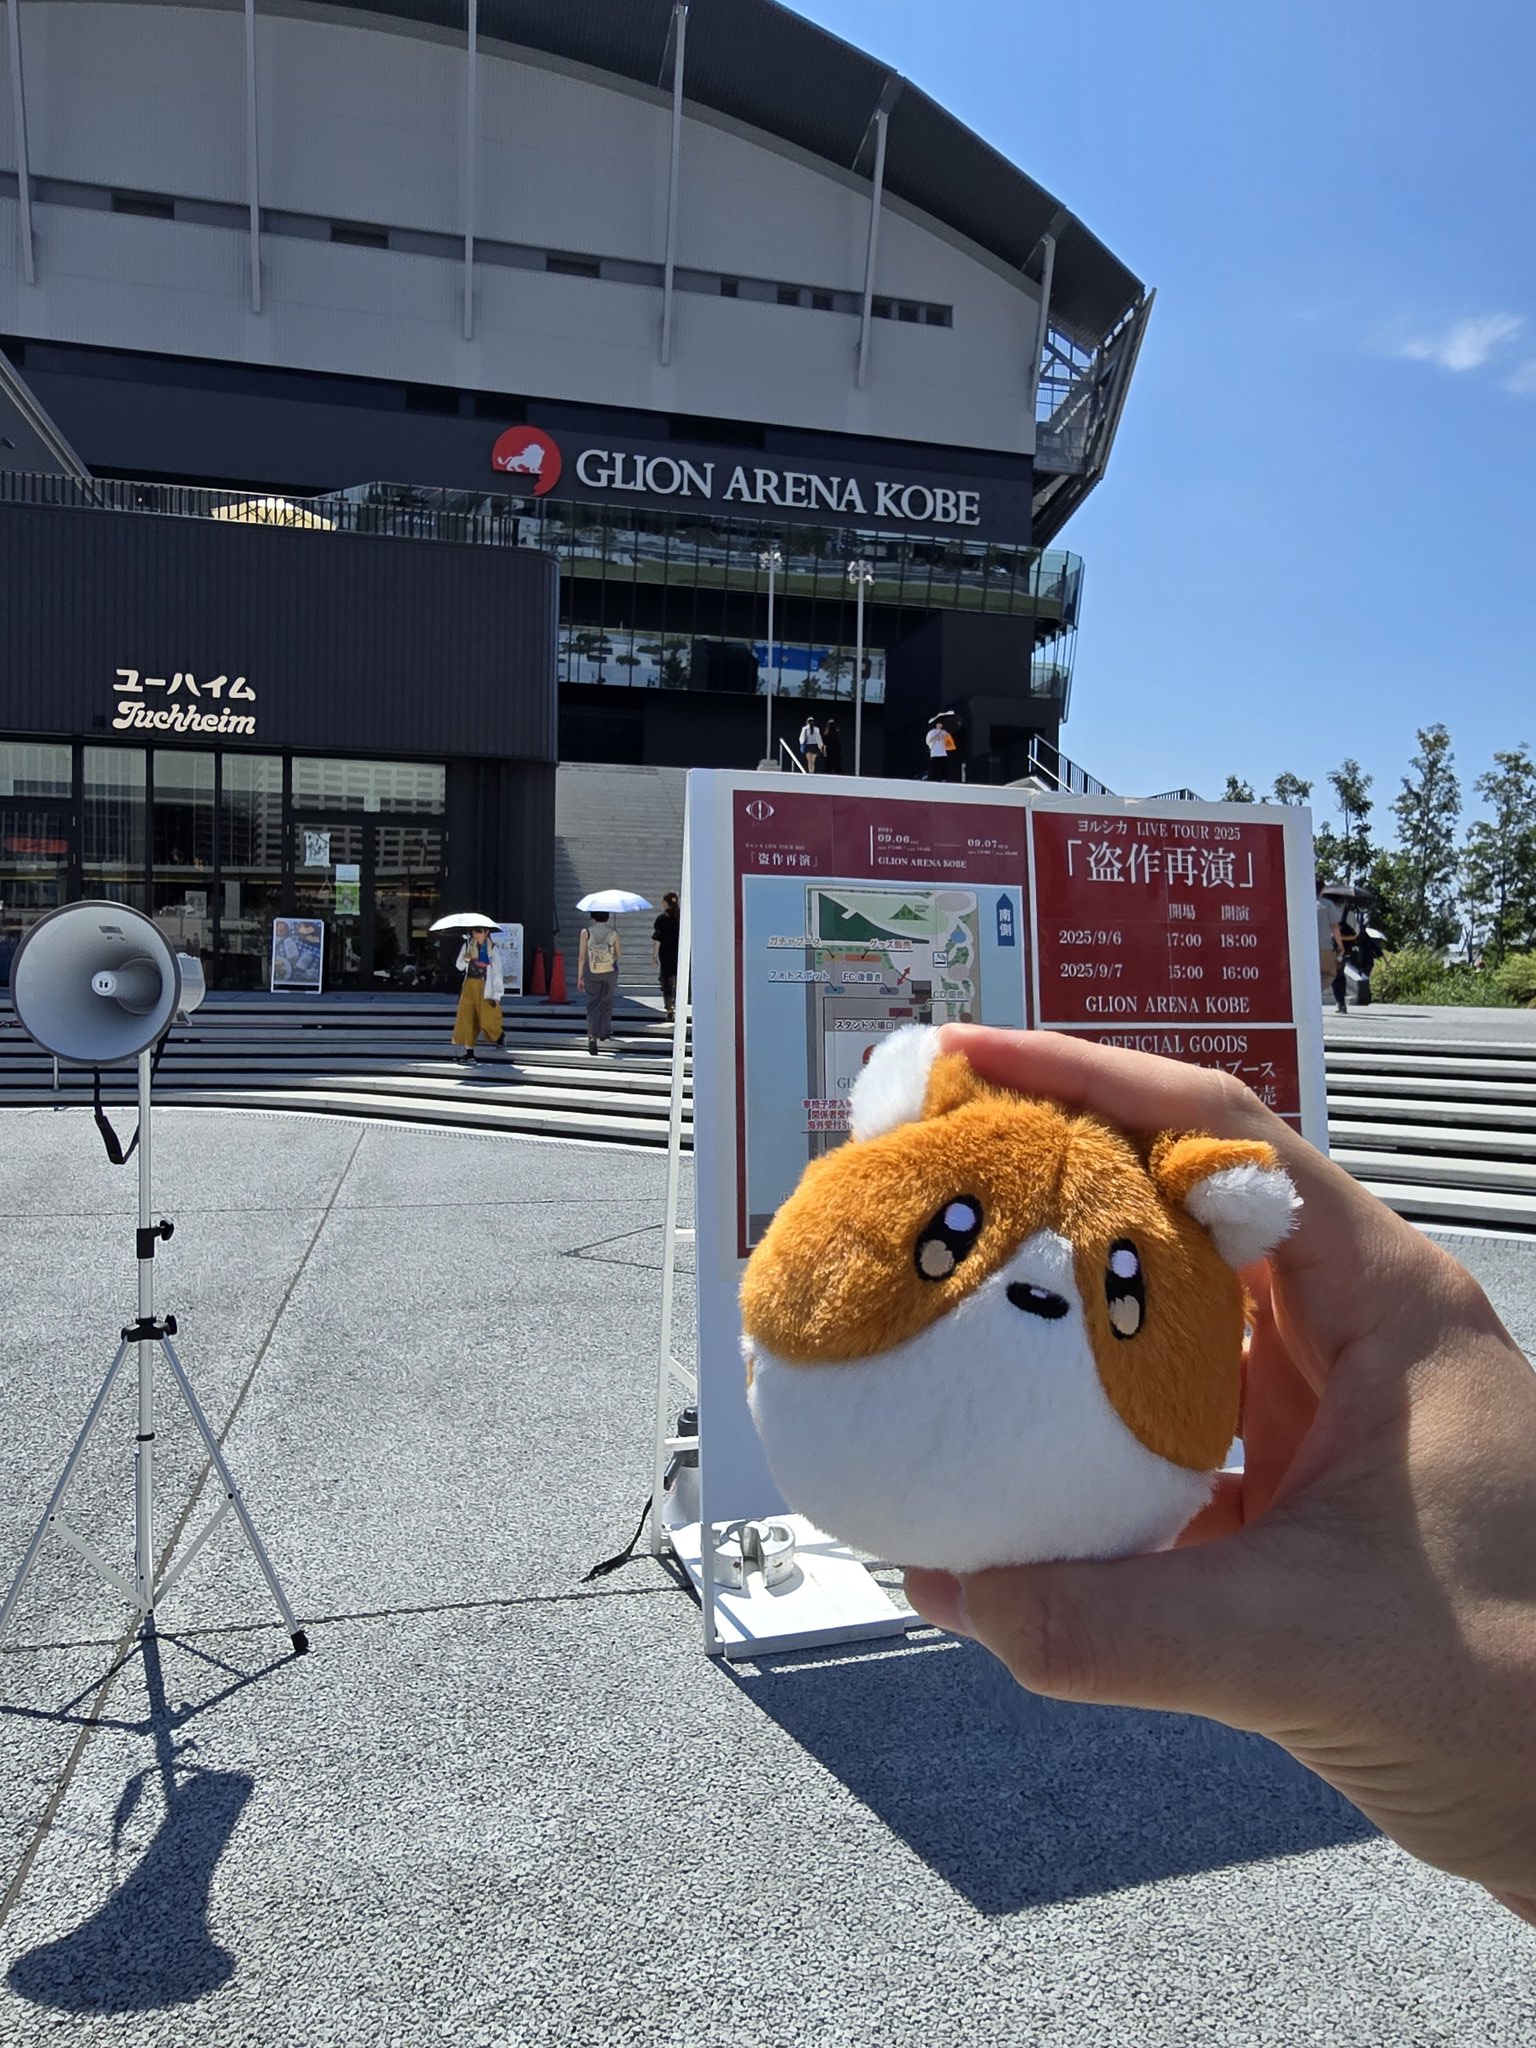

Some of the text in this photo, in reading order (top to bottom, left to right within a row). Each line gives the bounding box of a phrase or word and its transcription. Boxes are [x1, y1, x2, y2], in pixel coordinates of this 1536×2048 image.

[576, 449, 981, 527] GLION ARENA KOBE
[113, 668, 256, 701] ユーハイム
[1078, 820, 1241, 841] ヨルシカ LIVE TOUR 2025
[878, 856, 967, 869] GLION ARENA KOBE
[1068, 839, 1254, 888] 「盗作再演」
[1169, 903, 1250, 921] 開場 開演
[1059, 929, 1257, 948] 2025/9/6 17:00 18:00
[768, 970, 830, 981] フォトスポット
[1060, 963, 1259, 980] 2025/9/7 15:00 16:00
[1085, 996, 1250, 1014] GLION ARENA KOBE
[1189, 1035, 1248, 1054] GOODS
